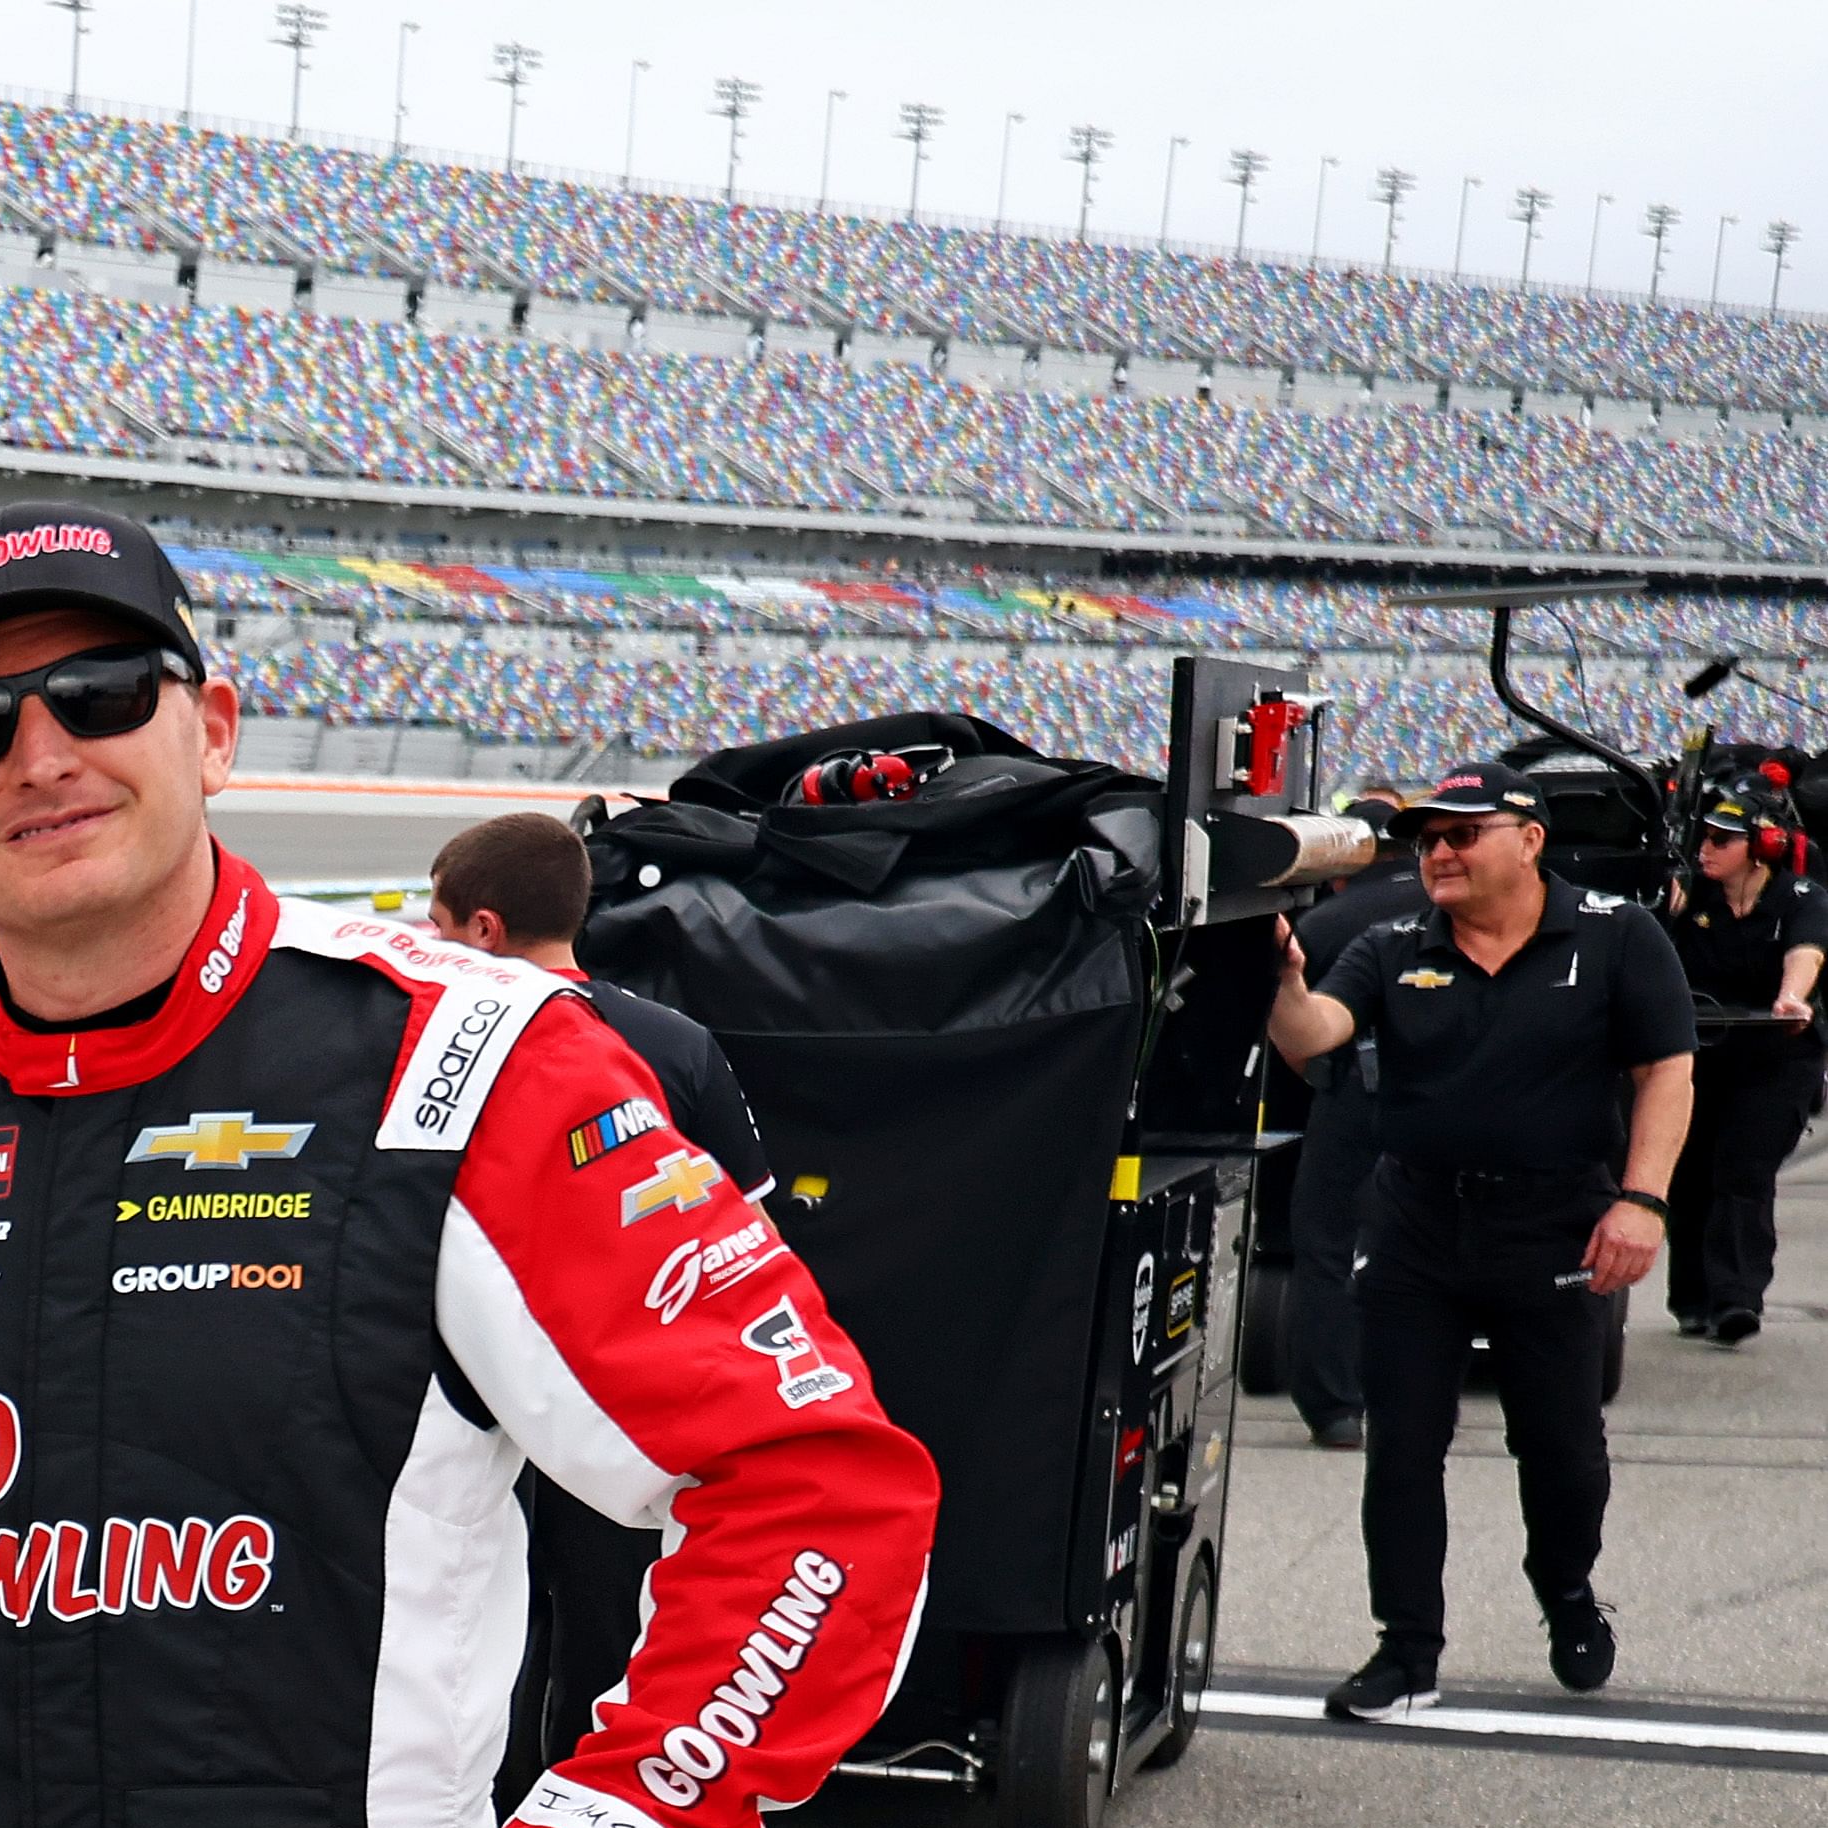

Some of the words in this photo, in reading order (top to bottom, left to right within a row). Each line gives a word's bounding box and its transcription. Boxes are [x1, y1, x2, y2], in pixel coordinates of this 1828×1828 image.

[332, 921, 386, 940] GO
[199, 948, 232, 993] GO
[415, 998, 502, 1136] sparco
[147, 1191, 312, 1222] GAINBRIDGE
[111, 1262, 303, 1294] GROUP1001
